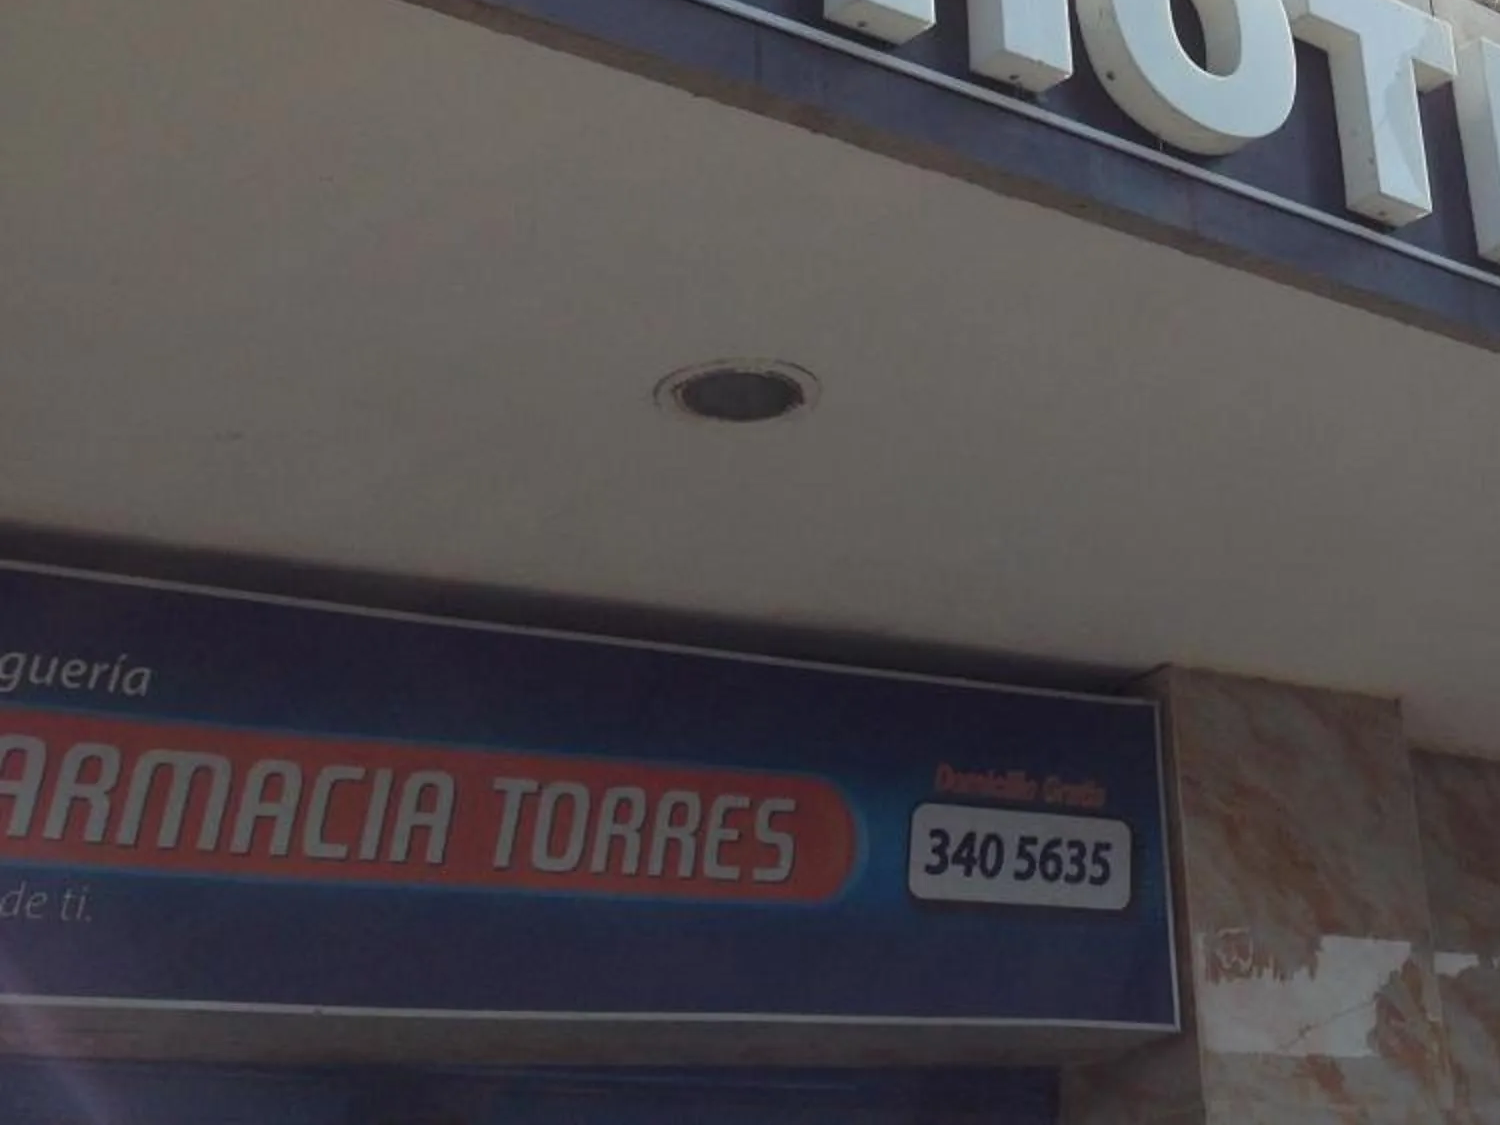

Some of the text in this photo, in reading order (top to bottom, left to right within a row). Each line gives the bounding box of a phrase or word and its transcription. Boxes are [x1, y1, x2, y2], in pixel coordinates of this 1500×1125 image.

[0, 651, 153, 698] guería
[0, 733, 797, 884] ARMACIA TORRES
[924, 828, 1113, 887] 340 5635
[0, 884, 49, 920] de
